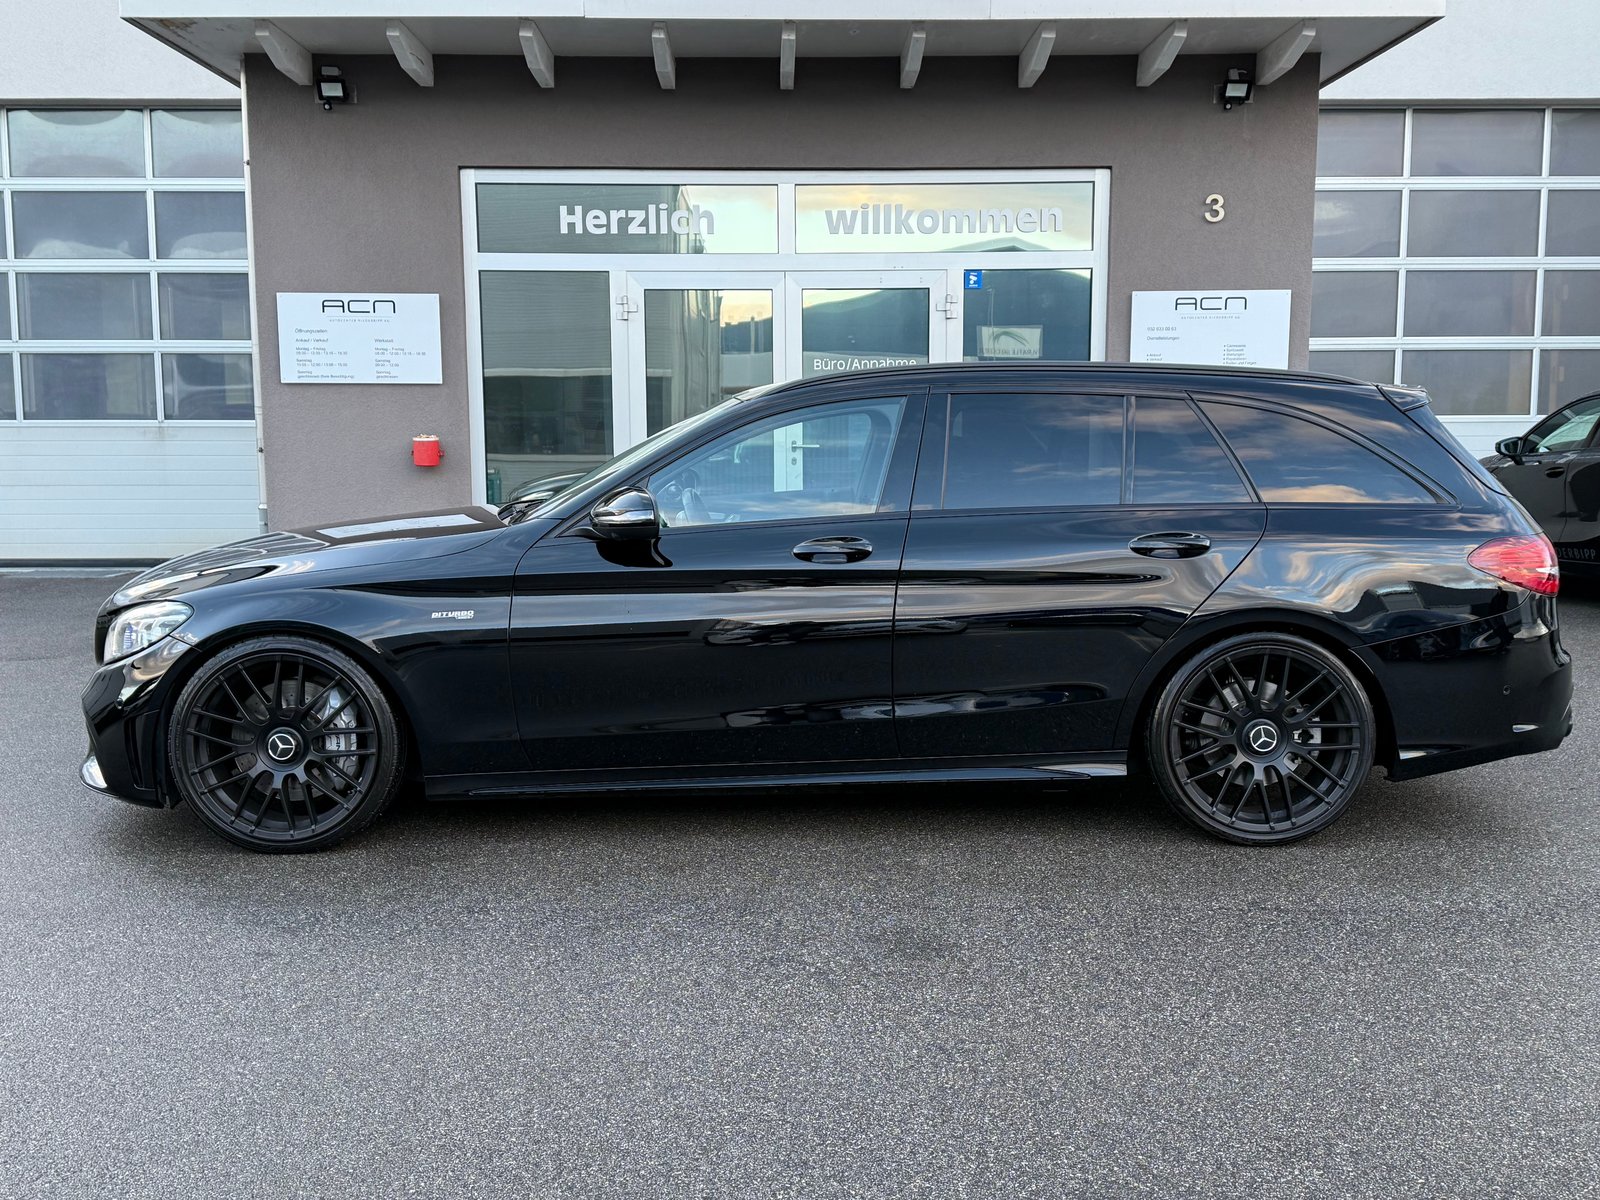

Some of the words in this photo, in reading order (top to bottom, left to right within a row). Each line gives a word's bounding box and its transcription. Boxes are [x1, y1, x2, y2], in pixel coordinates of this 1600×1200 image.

[559, 203, 715, 235] Herzlich
[825, 204, 1063, 234] willkommen
[1204, 193, 1225, 223] 3
